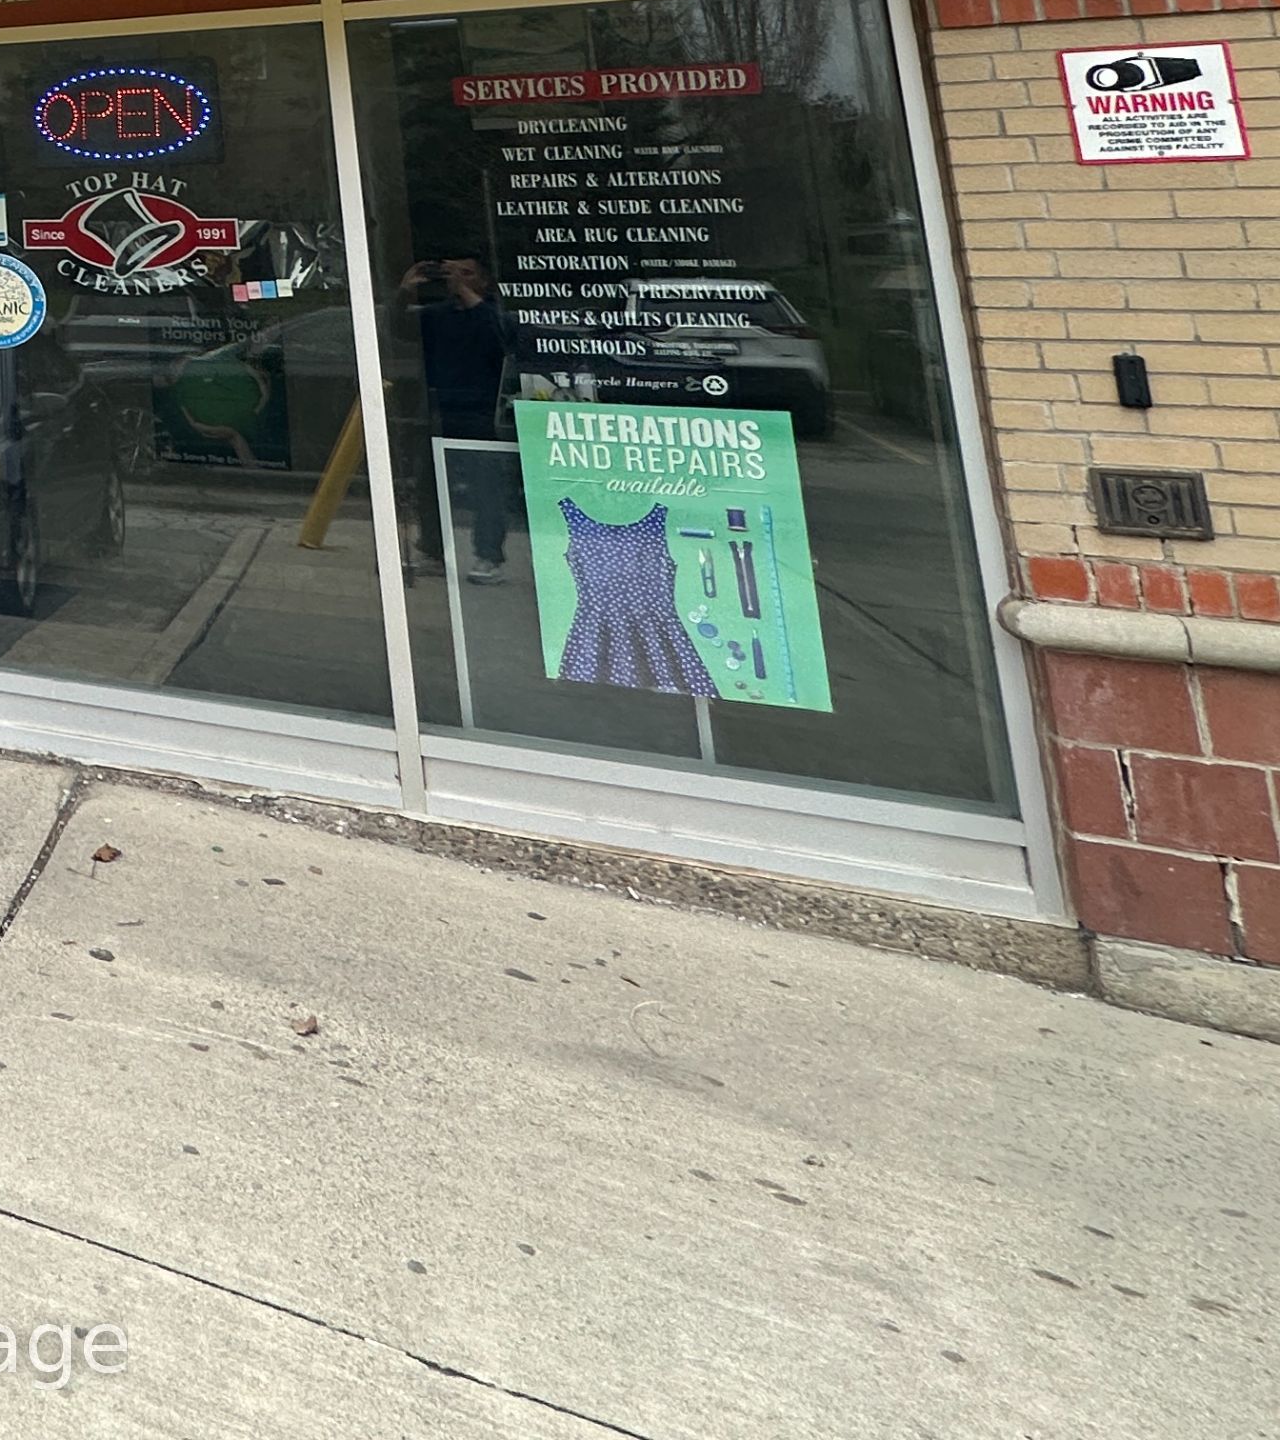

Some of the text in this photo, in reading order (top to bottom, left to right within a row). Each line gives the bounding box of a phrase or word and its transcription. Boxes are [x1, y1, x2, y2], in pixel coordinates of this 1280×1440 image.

[462, 67, 747, 102] SERVICES PROVIDED
[1086, 91, 1215, 115] WARNING
[40, 85, 195, 142] OPEN
[1125, 114, 1184, 122] ACTIVITIES
[517, 115, 627, 135] DRYCLEANING
[1088, 122, 1147, 130] RECORDED
[1098, 129, 1175, 137] PROSECUTION
[502, 146, 536, 162] WET
[543, 142, 623, 162] CLEANING
[1099, 145, 1144, 153] AGAINST
[1176, 142, 1225, 150] FACILITY
[66, 171, 188, 199] TOP HAT
[510, 169, 721, 189] REPAIRS & ALTERATIONS
[496, 196, 744, 217] LEATHER & SUEDE CLEANING
[31, 227, 227, 241] Since 1991
[535, 225, 710, 244] AREA RUG CLEANING
[517, 253, 629, 271] RESTORATION
[56, 256, 210, 297] CLEANERS
[498, 282, 767, 301] WEDDING GOWN PRESERVATION
[518, 308, 751, 330] DRAPES & QUILTS CLEANING
[535, 337, 647, 357] HOUSEHOLDS
[625, 377, 679, 391] Hangers
[545, 411, 762, 451] ALTERATIONS
[548, 442, 767, 481] AND REPAIRS
[605, 475, 707, 498] available
